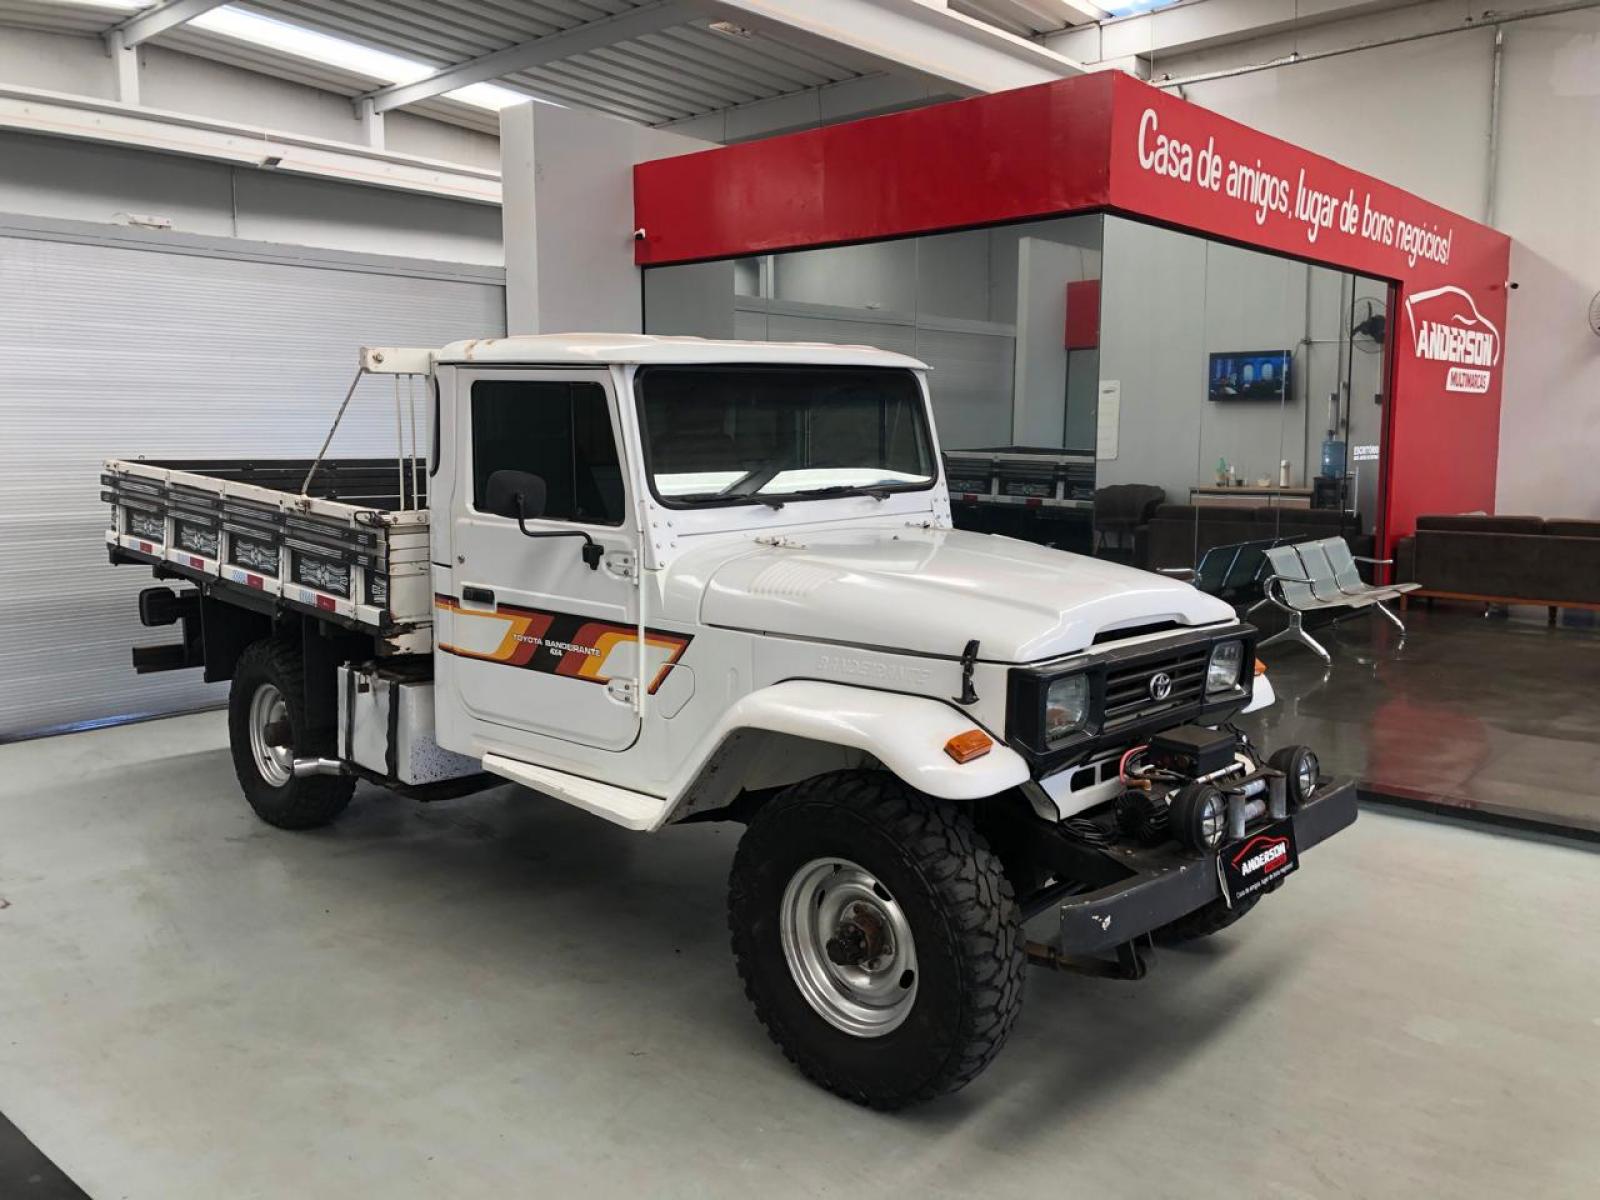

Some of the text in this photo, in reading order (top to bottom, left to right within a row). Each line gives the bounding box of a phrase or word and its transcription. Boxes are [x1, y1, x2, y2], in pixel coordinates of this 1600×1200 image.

[1138, 108, 1452, 268] Casa de amigos, lugar de bons negócios!
[1416, 320, 1493, 366] ANDERSON
[513, 633, 601, 657] TOYOTA BANDEIRANTE
[1241, 841, 1286, 877] ANDERSON
